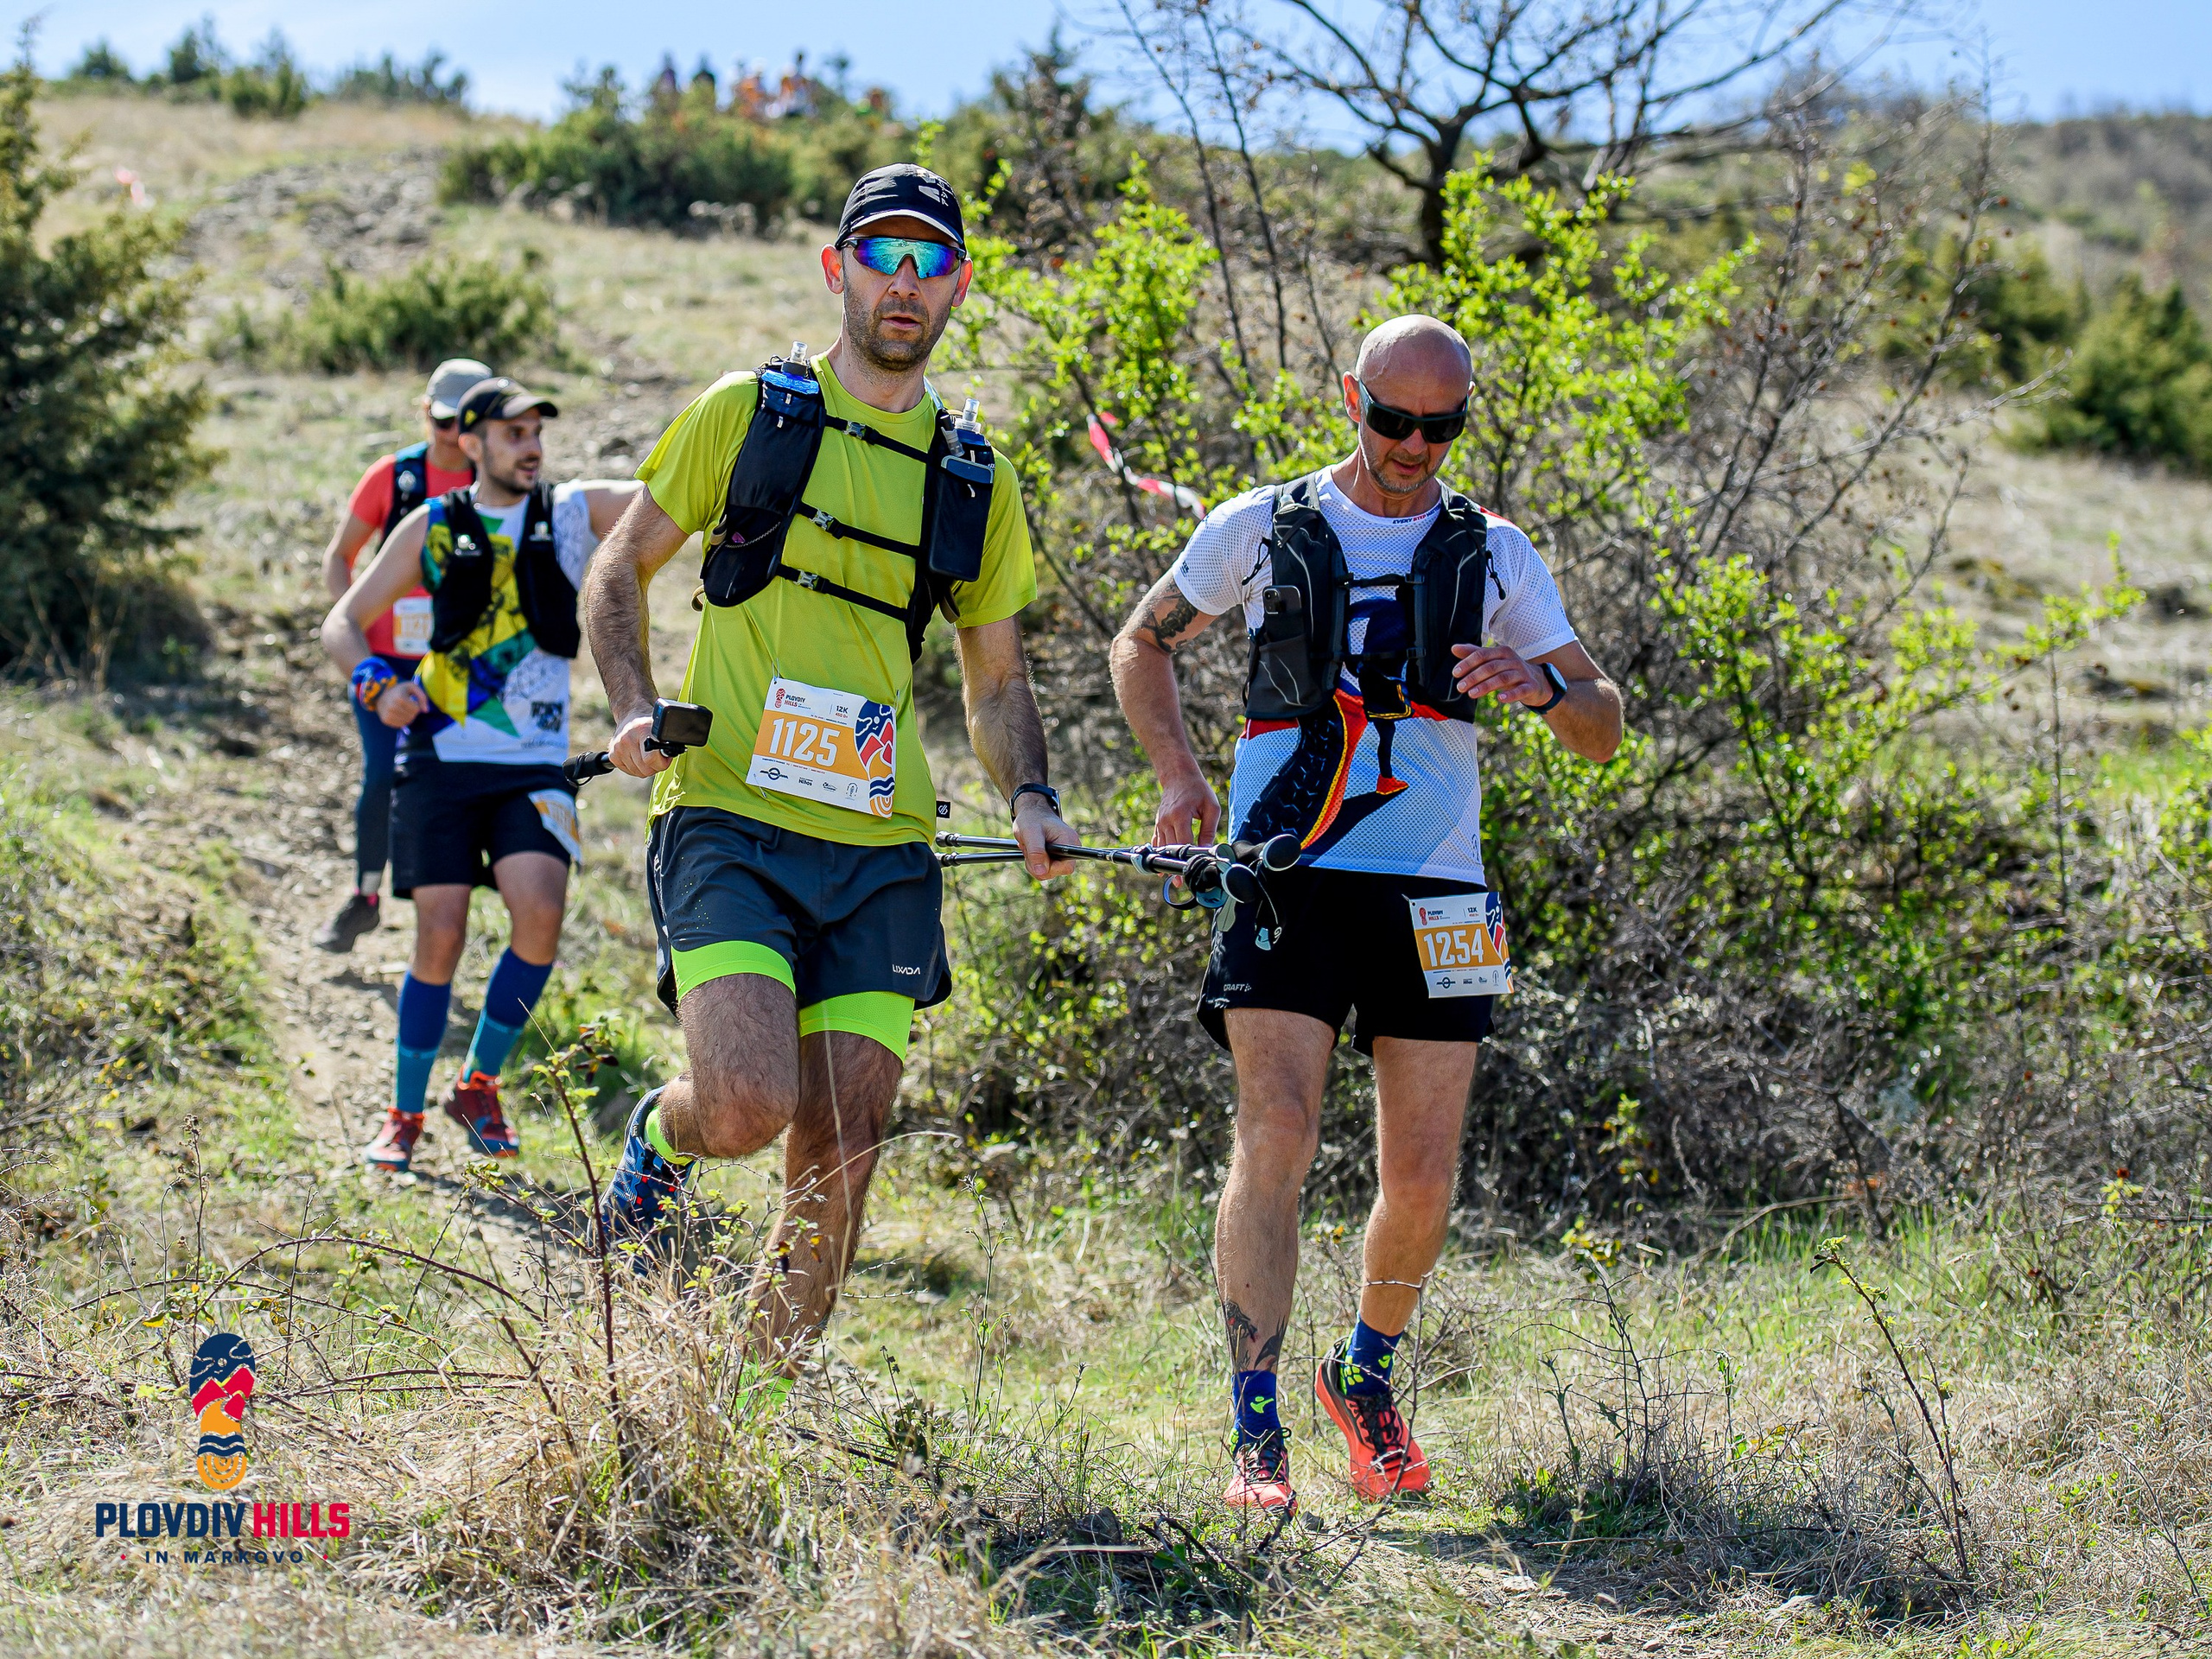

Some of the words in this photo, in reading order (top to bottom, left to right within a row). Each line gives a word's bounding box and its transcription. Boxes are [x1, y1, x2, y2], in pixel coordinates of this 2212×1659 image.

[836, 705, 849, 714] 12K
[769, 717, 841, 767] 1125
[1423, 928, 1484, 967] 1254
[892, 963, 921, 976] LIXADA
[1223, 983, 1246, 992] CRAFT
